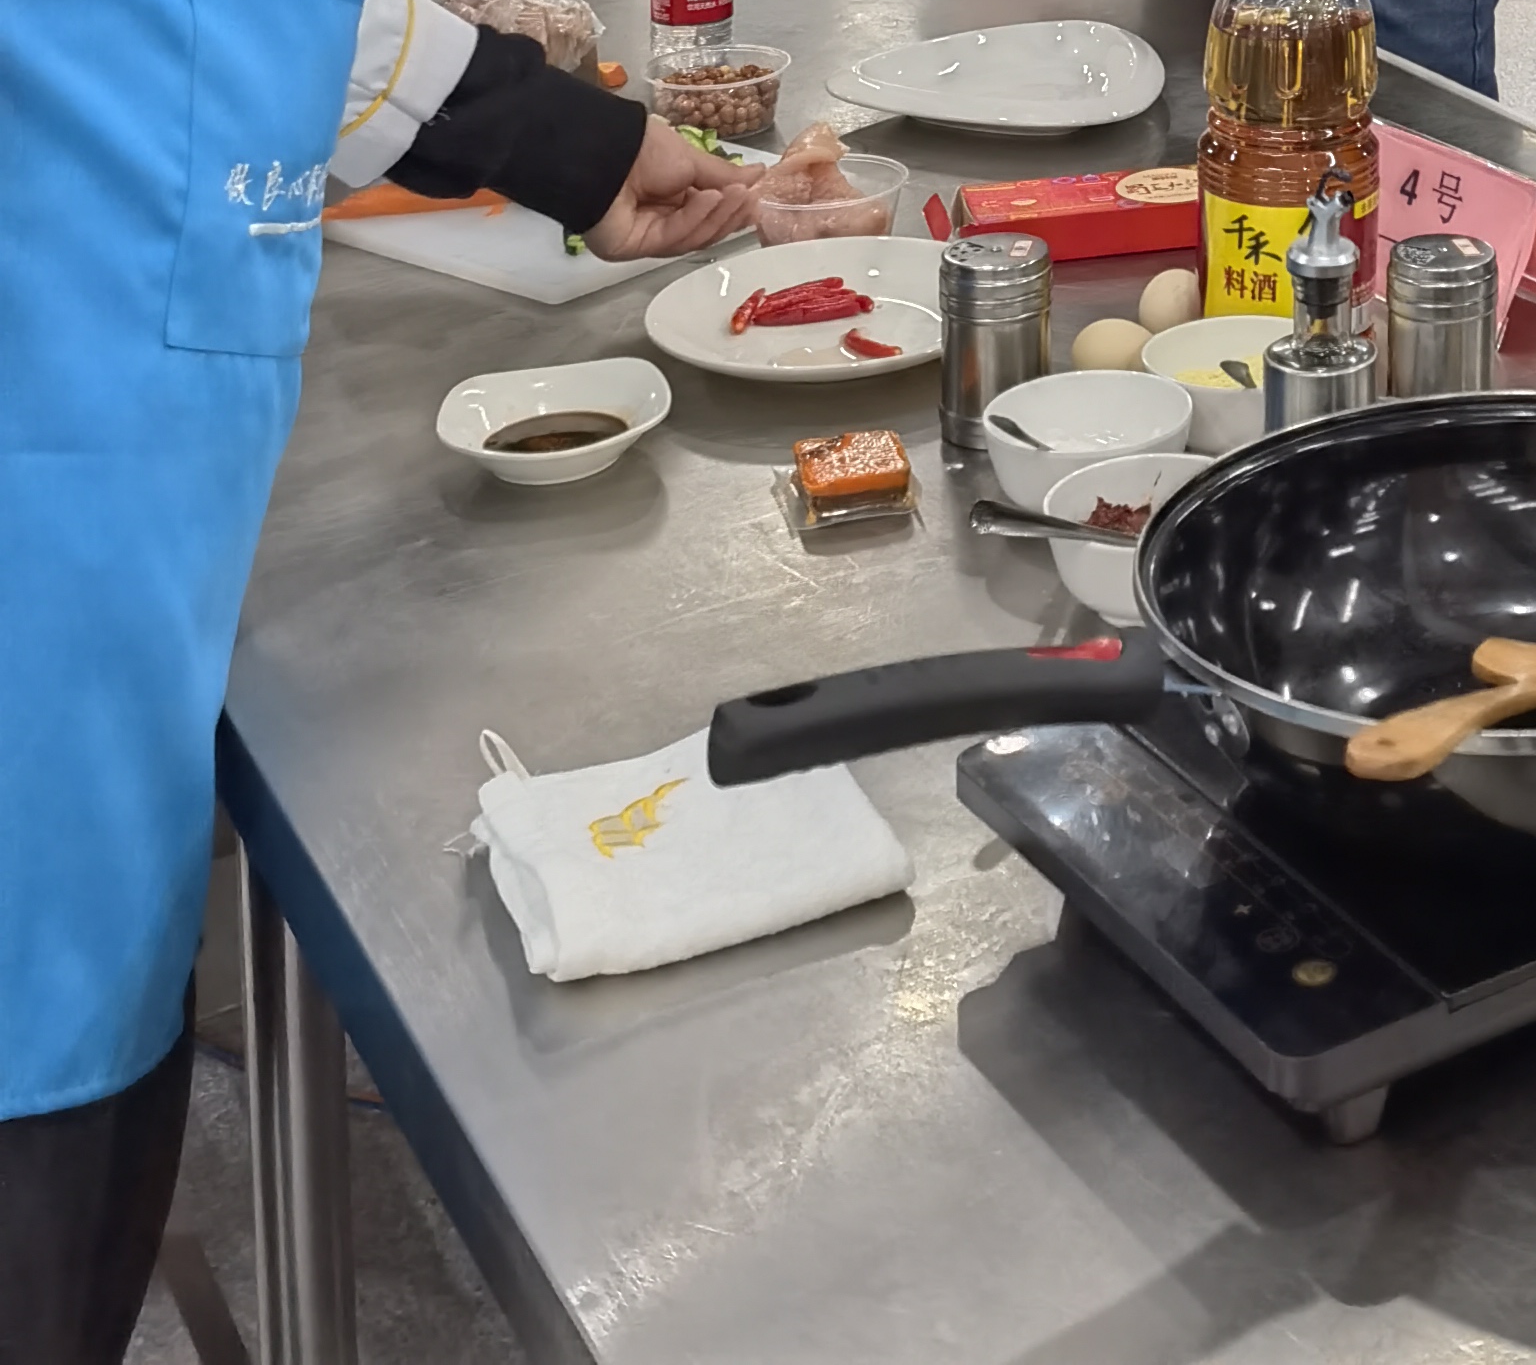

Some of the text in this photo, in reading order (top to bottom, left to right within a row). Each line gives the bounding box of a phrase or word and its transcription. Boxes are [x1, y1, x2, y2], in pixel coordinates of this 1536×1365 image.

[1400, 169, 1462, 224] 4号
[1223, 214, 1282, 265] 千禾
[1224, 266, 1278, 302] 料酒
